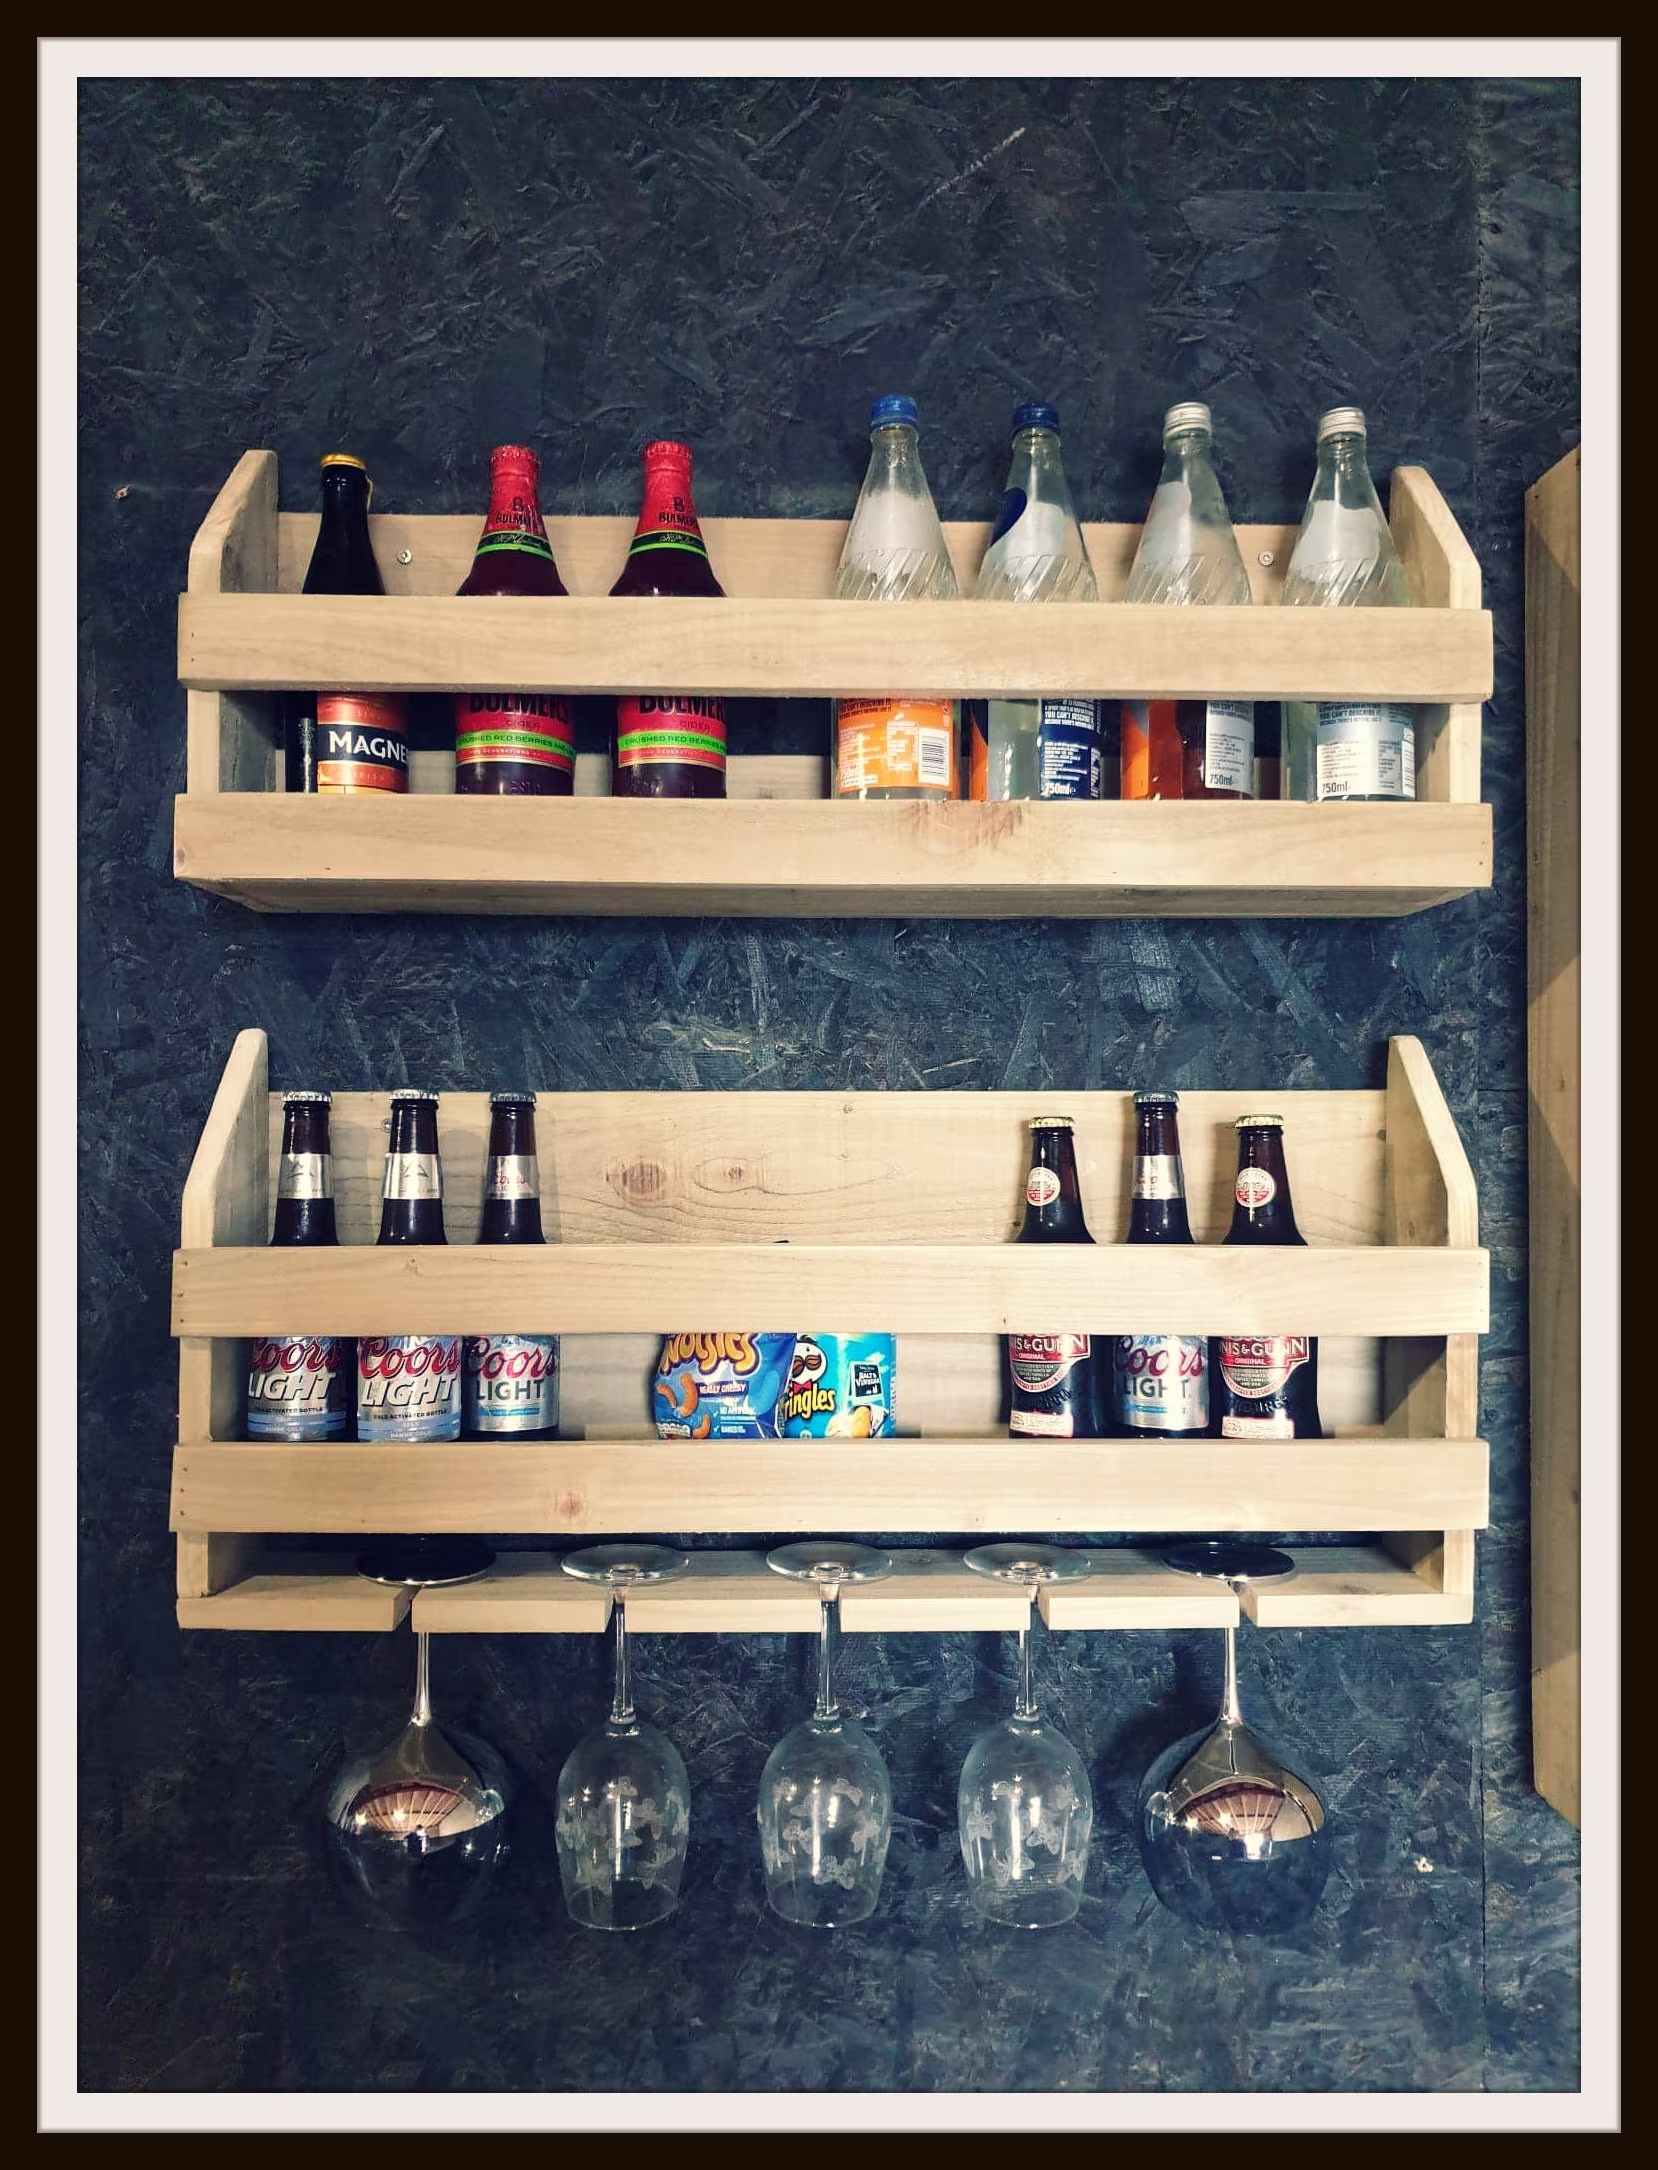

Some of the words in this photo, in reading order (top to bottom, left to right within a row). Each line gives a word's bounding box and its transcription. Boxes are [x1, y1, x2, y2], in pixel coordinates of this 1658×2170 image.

[1210, 774, 1233, 785] 750ml
[1322, 781, 1348, 794] 750ml
[360, 1336, 460, 1379] Coors
[465, 1336, 557, 1379] Coors
[248, 1372, 337, 1401] LIGHT
[360, 1373, 458, 1407] LIGHT
[475, 1379, 545, 1401] LIGHT
[784, 1383, 837, 1420] ringles
